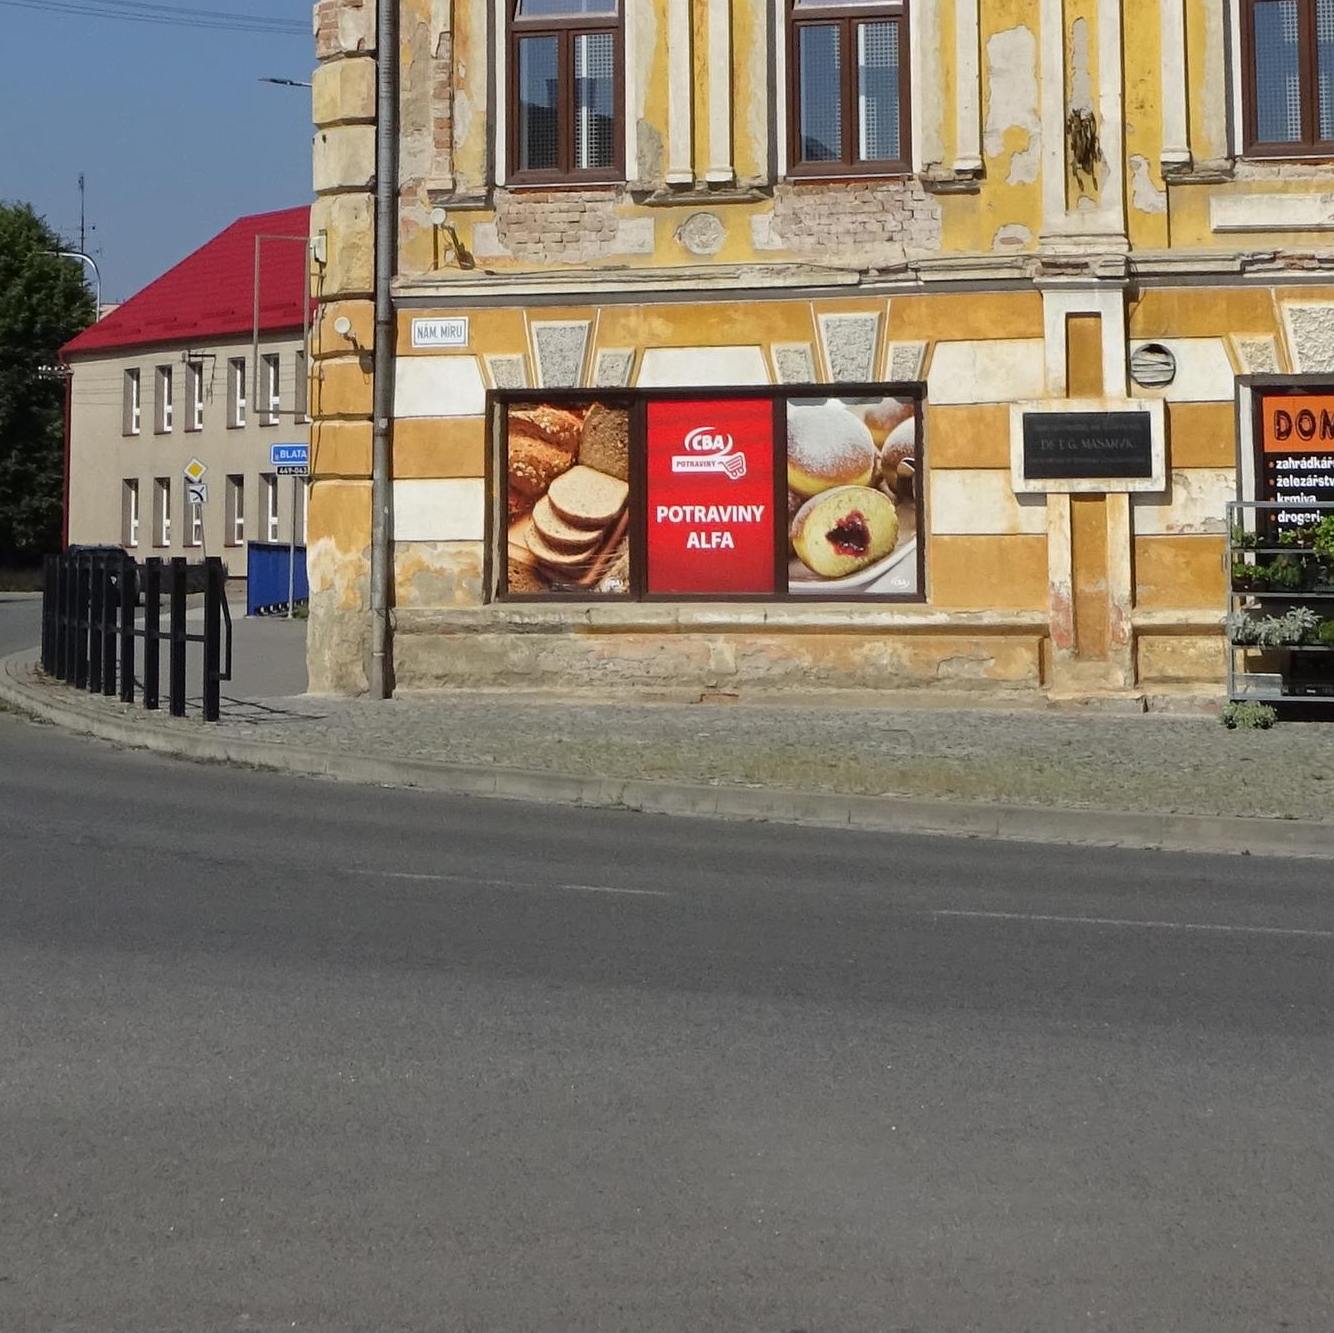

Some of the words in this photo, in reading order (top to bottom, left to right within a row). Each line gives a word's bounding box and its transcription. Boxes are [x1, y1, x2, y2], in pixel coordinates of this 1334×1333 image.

[417, 323, 438, 339] NÁM.
[440, 322, 463, 338] MÍRU
[691, 434, 726, 451] CBA
[280, 449, 307, 458] BLATA
[676, 460, 716, 468] POTRAVINY
[656, 505, 765, 523] POTRAVINY
[686, 531, 735, 549] ALFA
